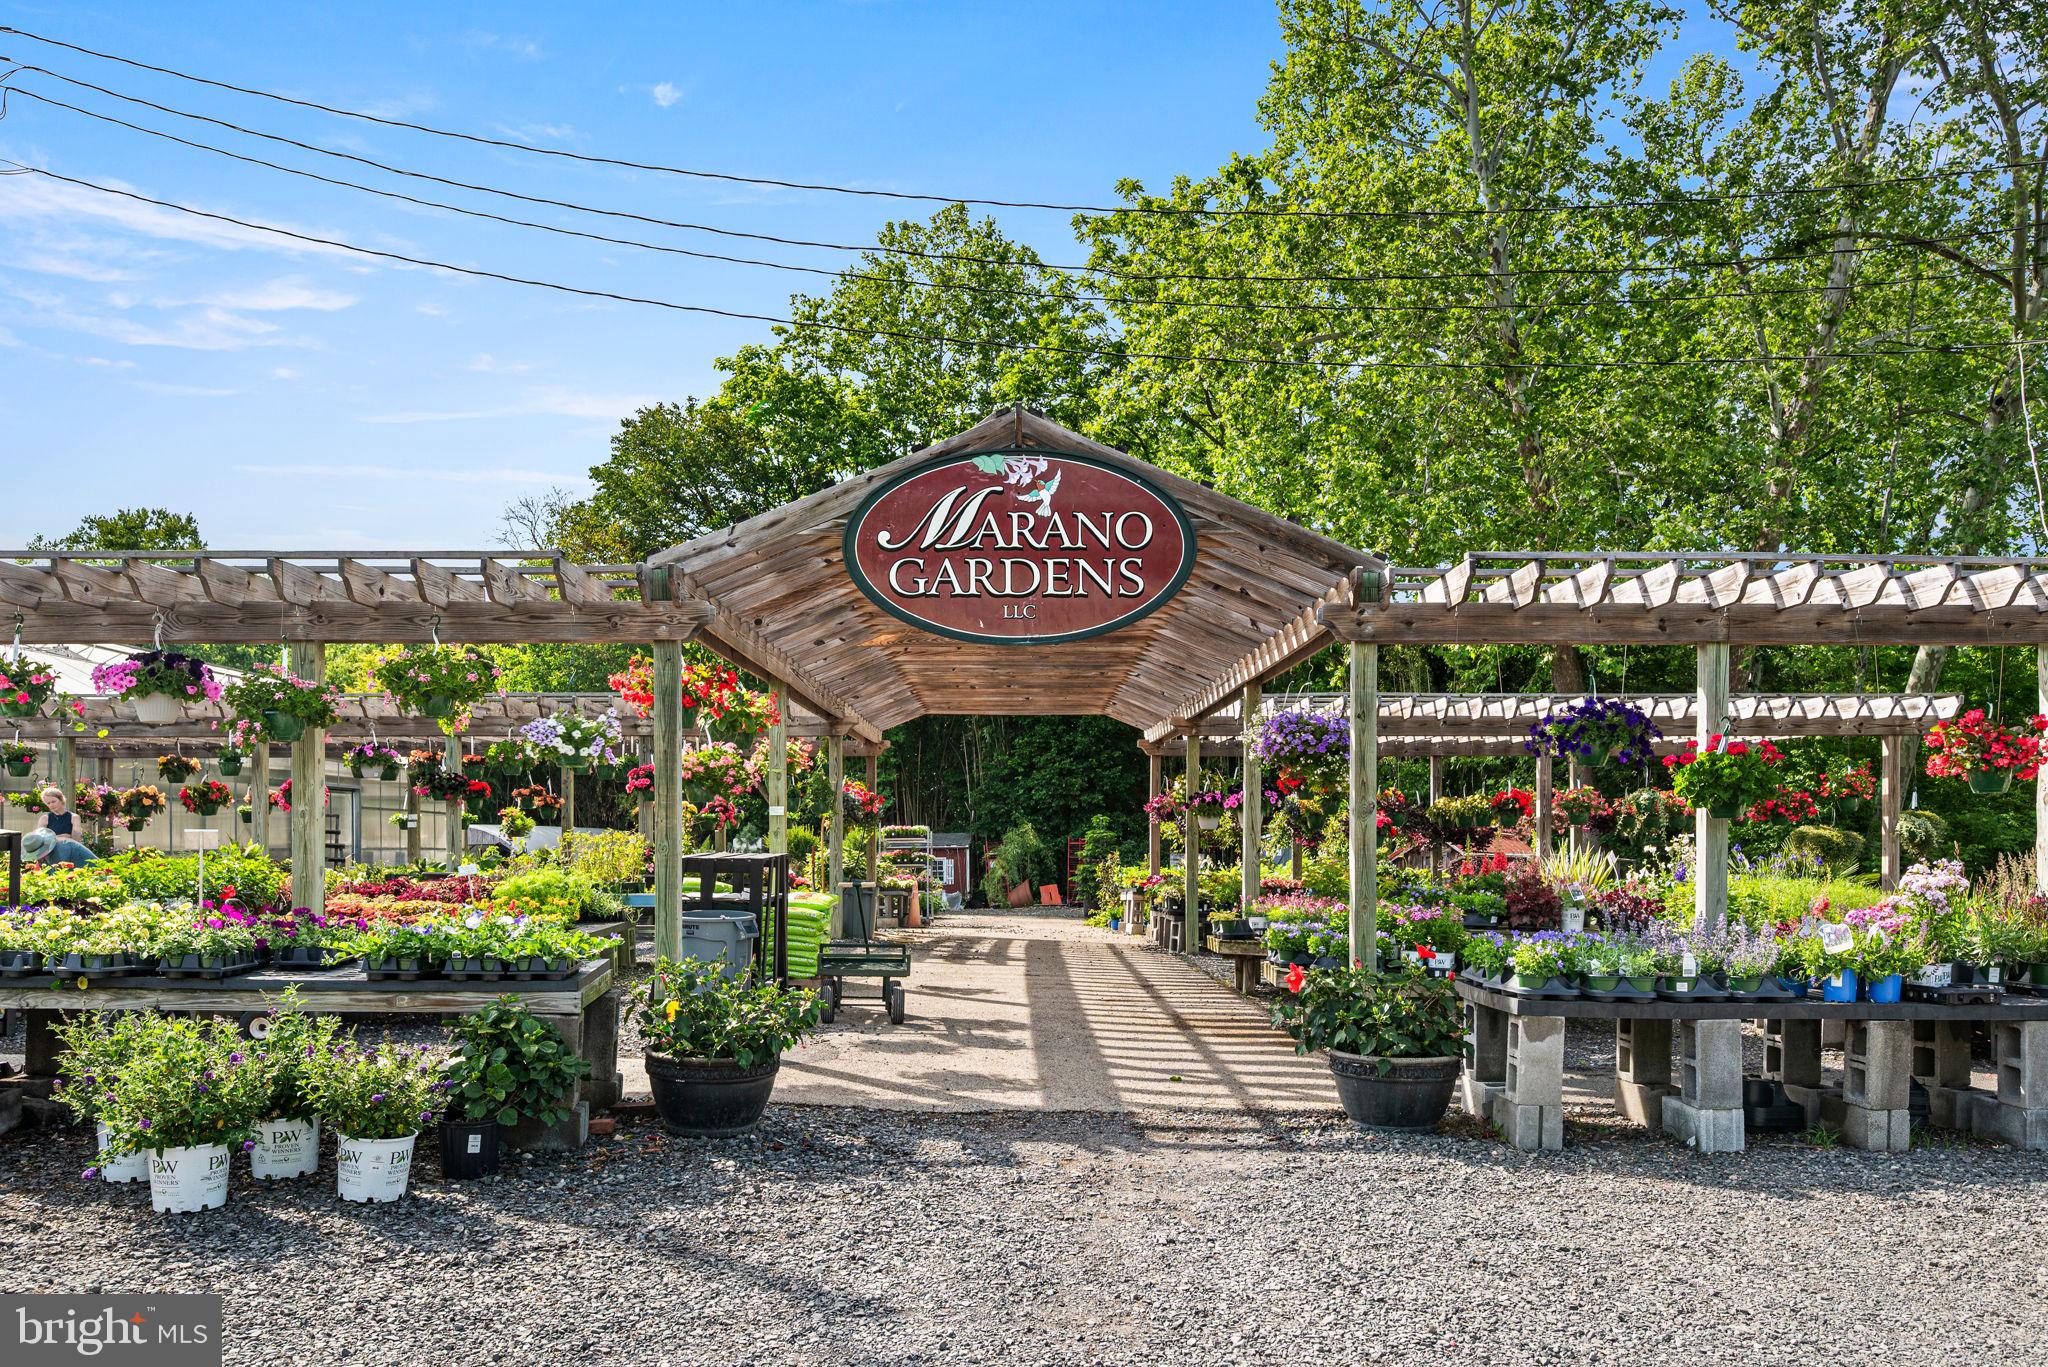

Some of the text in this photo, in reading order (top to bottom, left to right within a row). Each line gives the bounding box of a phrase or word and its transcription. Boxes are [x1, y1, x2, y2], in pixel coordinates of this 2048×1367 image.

[878, 486, 1153, 550] MARANO
[889, 557, 1145, 598] GARDENS
[1003, 605, 1037, 619] LLC
[272, 1130, 302, 1144] PW
[390, 1148, 412, 1164] PW
[152, 1159, 179, 1174] PW
